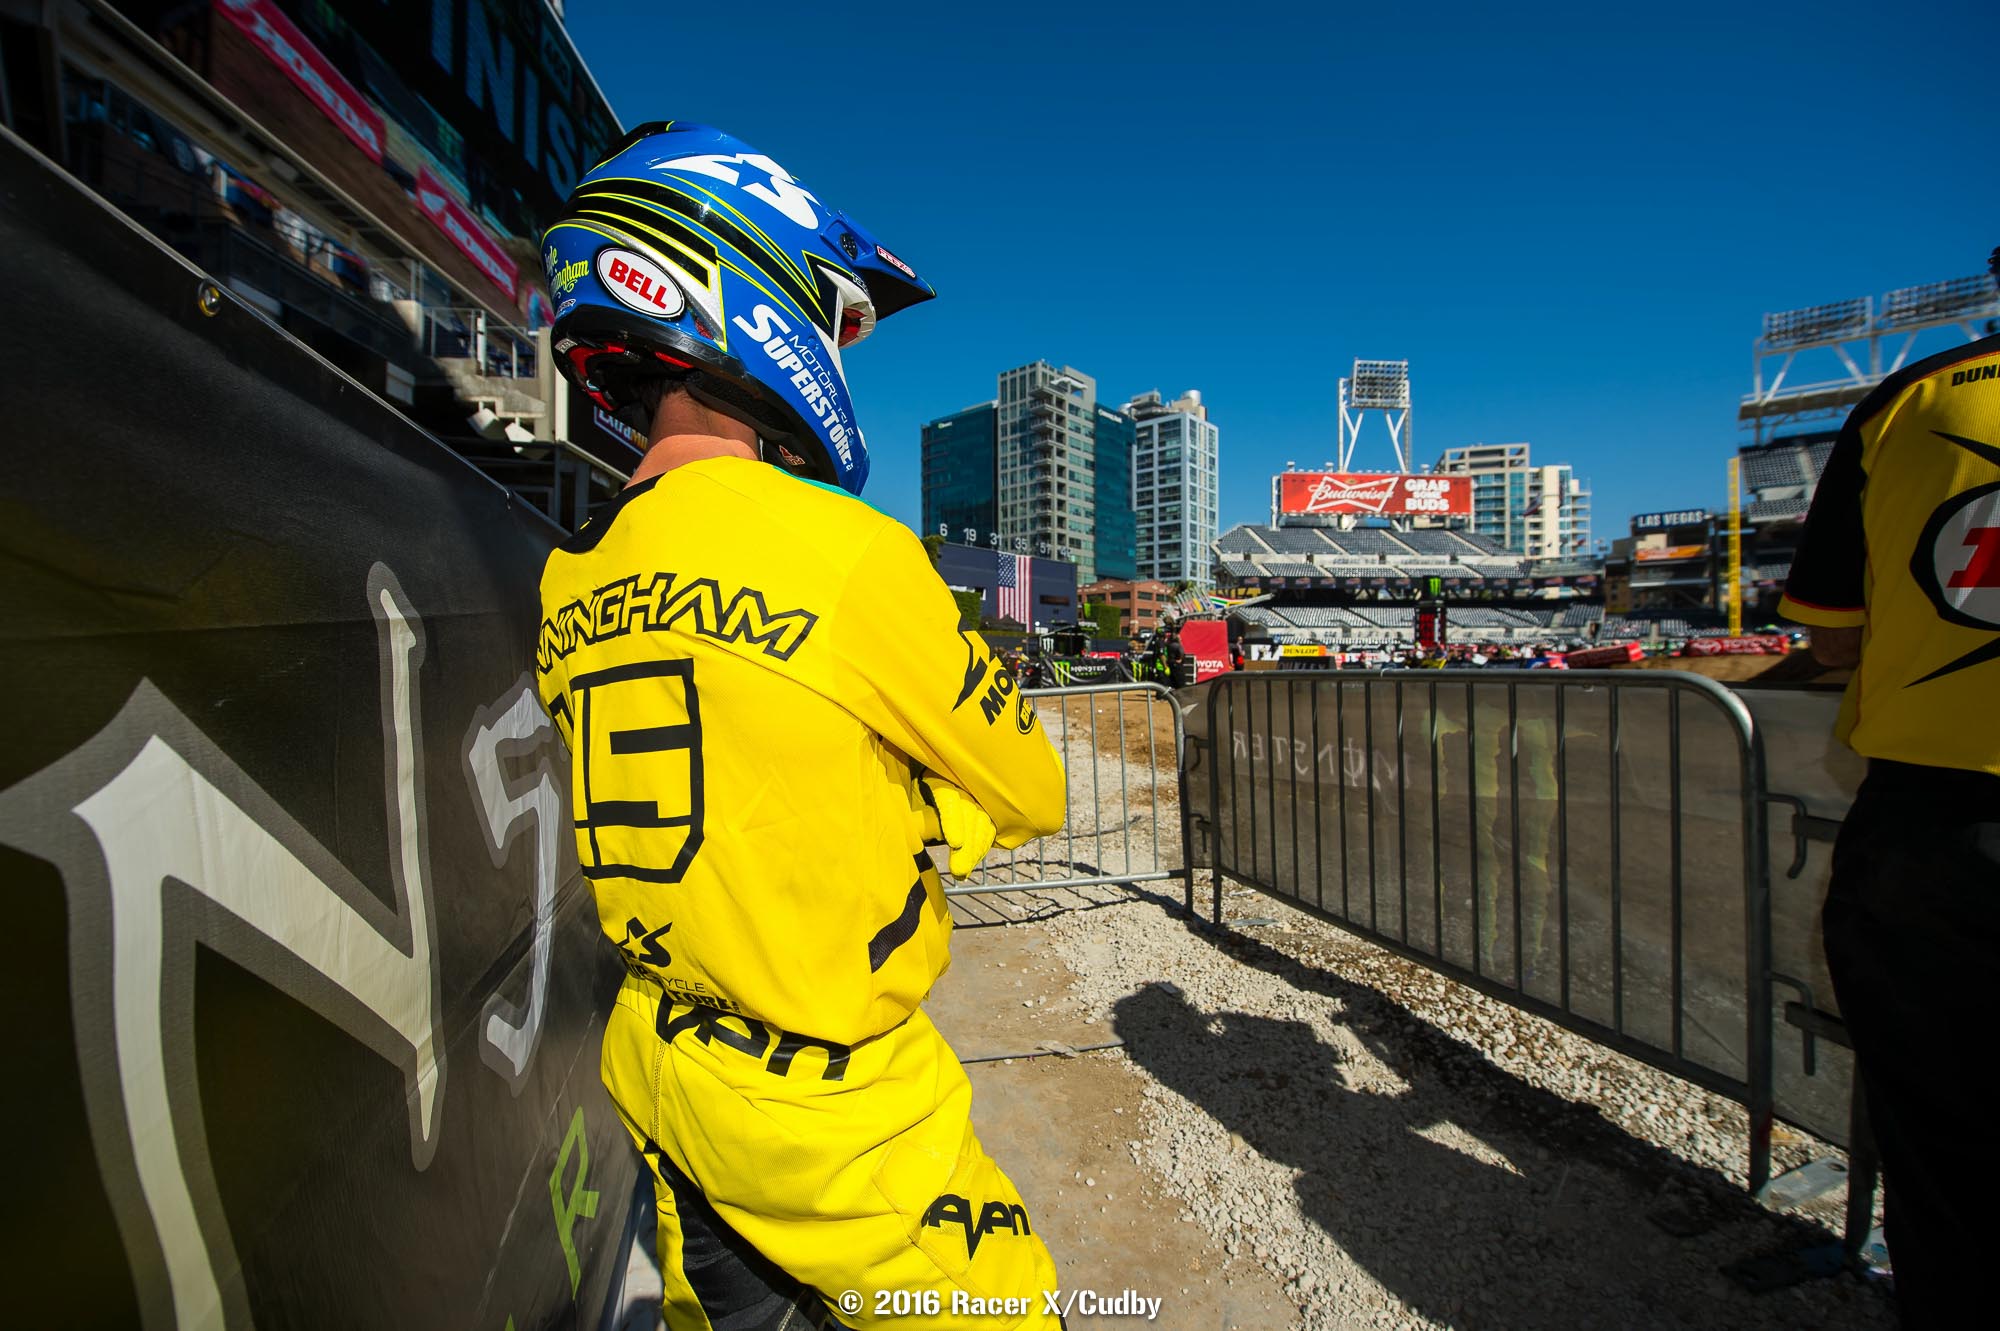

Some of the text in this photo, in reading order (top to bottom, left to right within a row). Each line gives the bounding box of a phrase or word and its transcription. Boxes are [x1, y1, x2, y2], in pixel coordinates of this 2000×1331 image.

[609, 257, 667, 310] BELL
[1952, 364, 2000, 386] DUN
[1308, 482, 1394, 501] Budweiser
[1404, 479, 1450, 493] GRAB
[1405, 498, 1450, 511] BUDS
[1638, 511, 1705, 528] LAS VEGAS
[940, 523, 948, 536] 6
[963, 528, 977, 541] 19
[990, 533, 1002, 545] 31
[1015, 538, 1027, 550] 35
